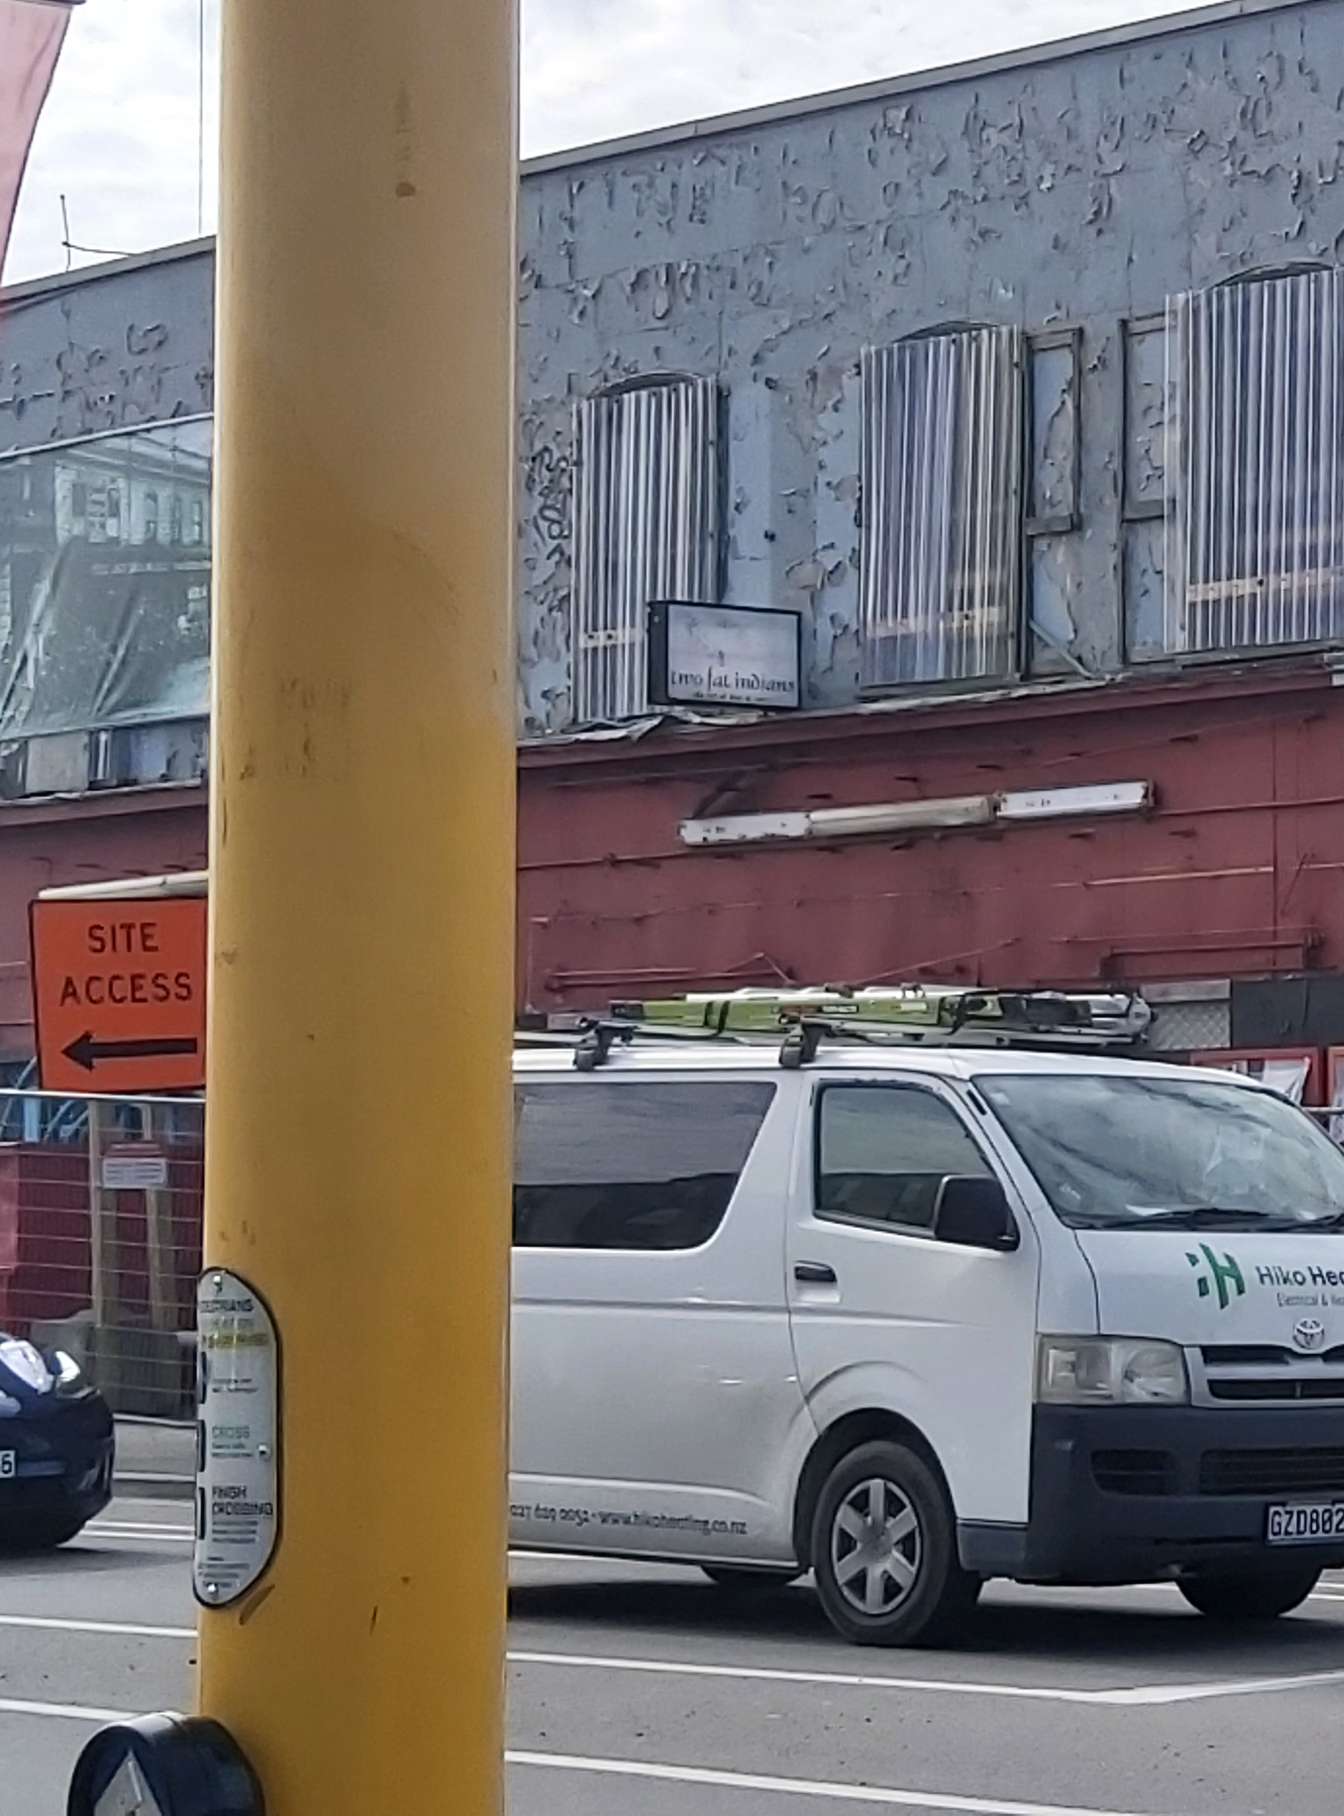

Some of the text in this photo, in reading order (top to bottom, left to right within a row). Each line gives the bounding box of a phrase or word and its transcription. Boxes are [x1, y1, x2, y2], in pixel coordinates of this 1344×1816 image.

[671, 665, 795, 693] two fat indians
[88, 922, 159, 953] SITE
[59, 971, 193, 1007] ACCESS
[1256, 1265, 1306, 1287] Hiko
[1, 1453, 13, 1474] 6
